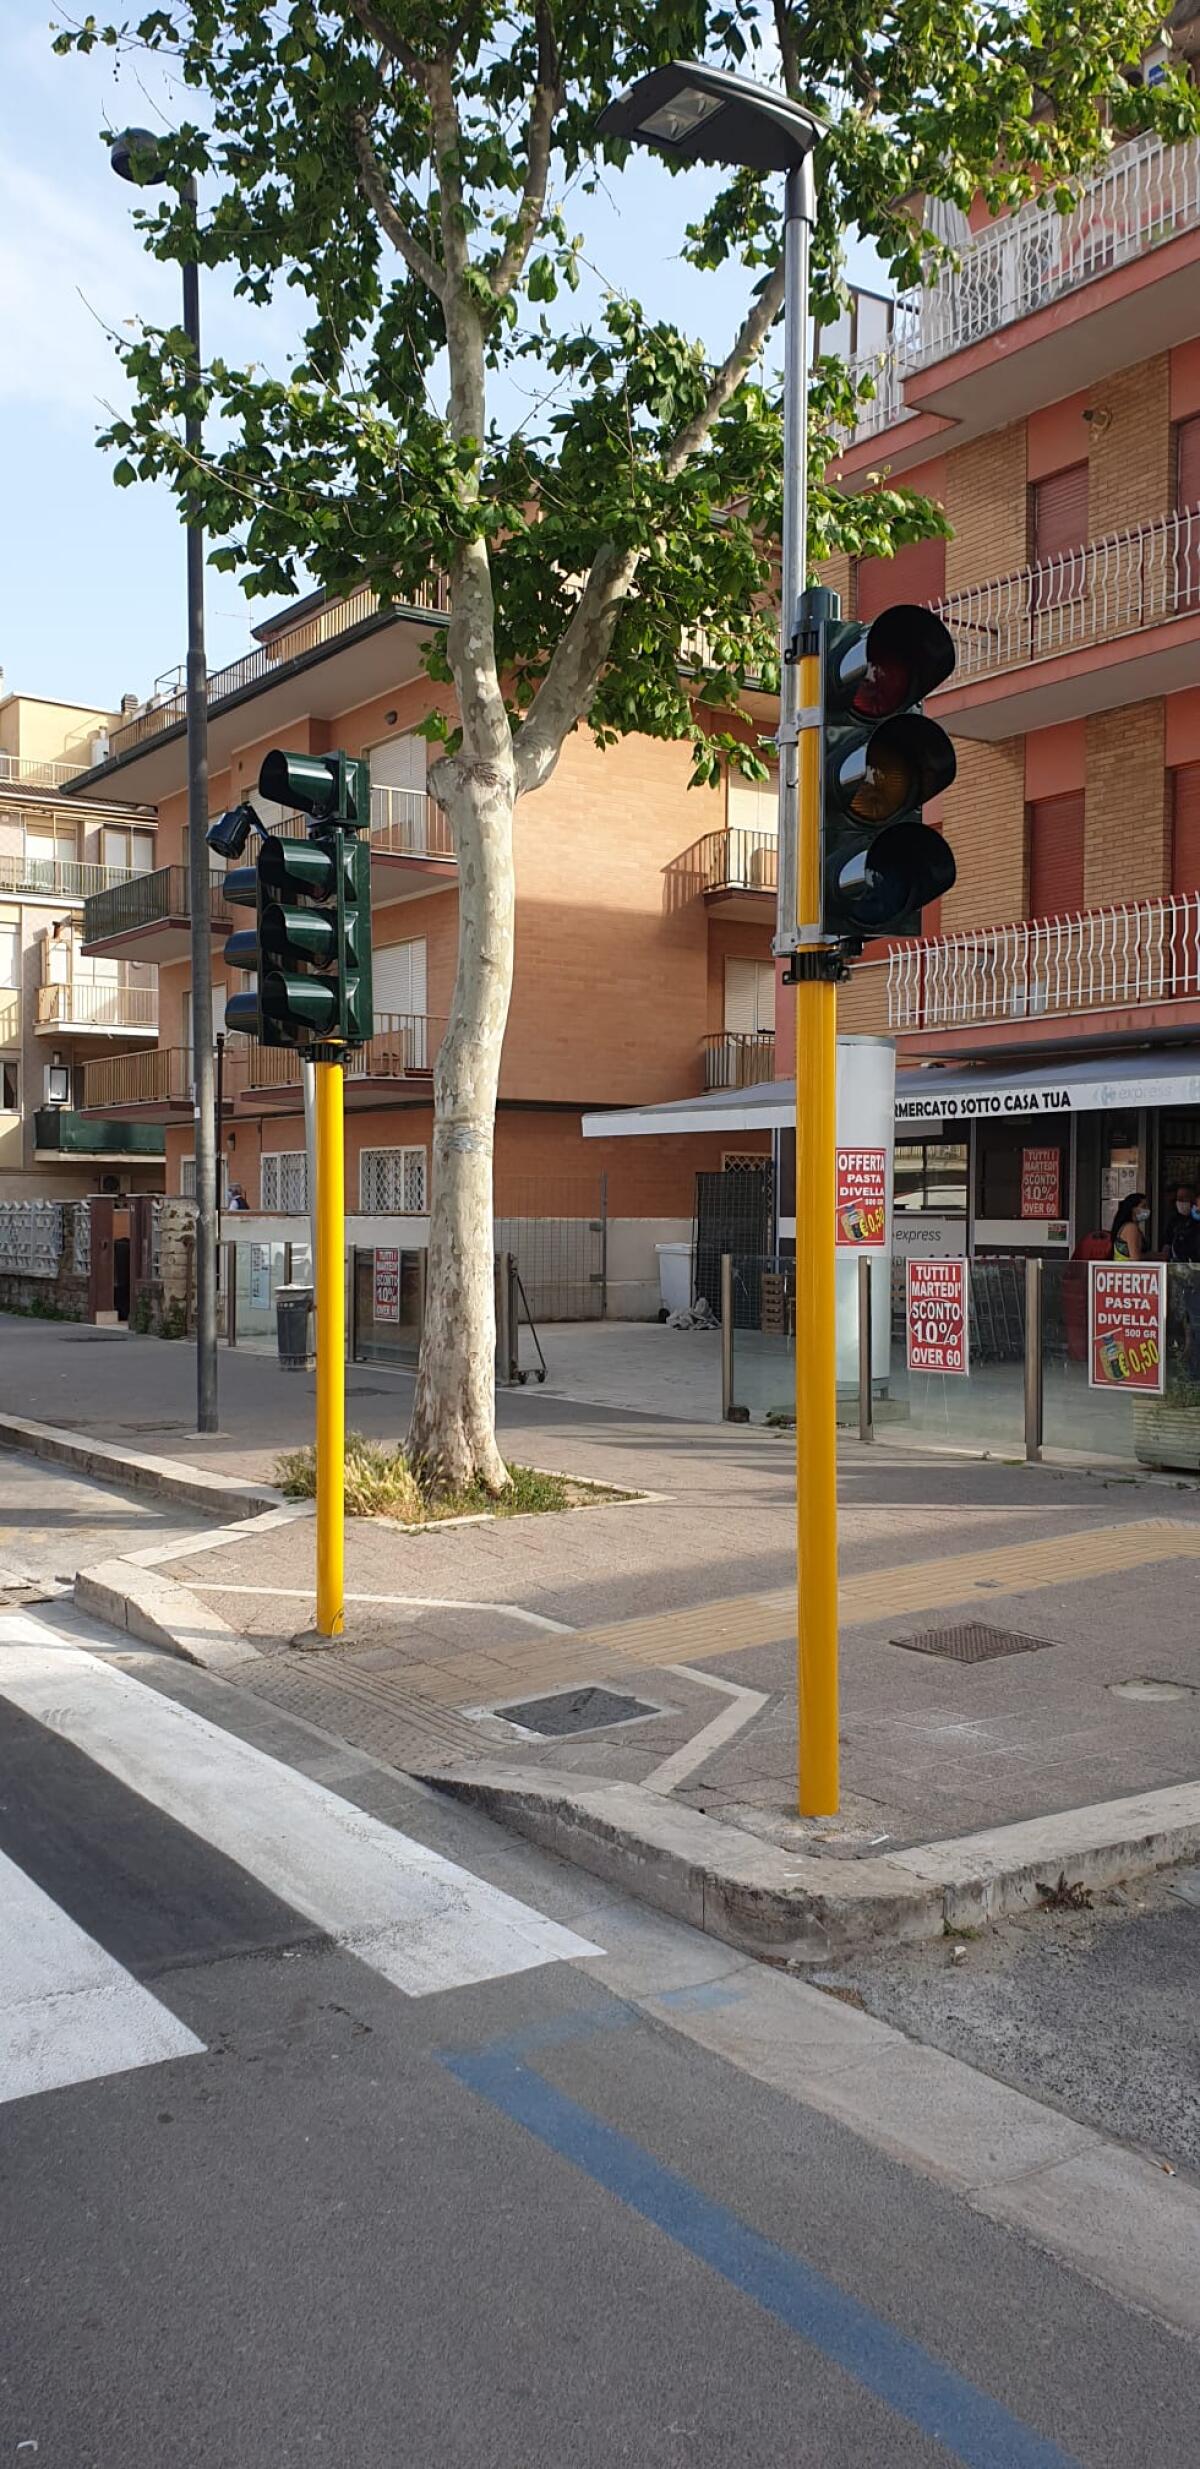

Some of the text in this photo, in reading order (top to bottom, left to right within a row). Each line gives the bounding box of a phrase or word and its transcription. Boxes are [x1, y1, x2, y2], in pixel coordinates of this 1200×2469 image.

[961, 1097, 1000, 1114] SOTTO
[1004, 1094, 1039, 1110] CASA
[1042, 1091, 1071, 1108] TUA
[838, 1154, 885, 1171] OFFERTA
[1029, 1151, 1050, 1161] TUTTI
[847, 1173, 881, 1183] PASTA
[1024, 1174, 1057, 1185] SCONTO
[839, 1187, 884, 1196] DIVELLA
[1025, 1186, 1055, 1201] 10%
[1024, 1203, 1044, 1214] OVER
[895, 1230, 942, 1244] express
[916, 1266, 956, 1281] TUTTI I
[1096, 1271, 1159, 1294] OFFERTA
[1105, 1297, 1151, 1310] PASTA
[911, 1301, 960, 1321] SCONTO
[1098, 1313, 1158, 1327] DIVELLA
[913, 1320, 958, 1346] 10%
[1124, 1329, 1157, 1338] 500 GR
[912, 1347, 961, 1366] OVER 60
